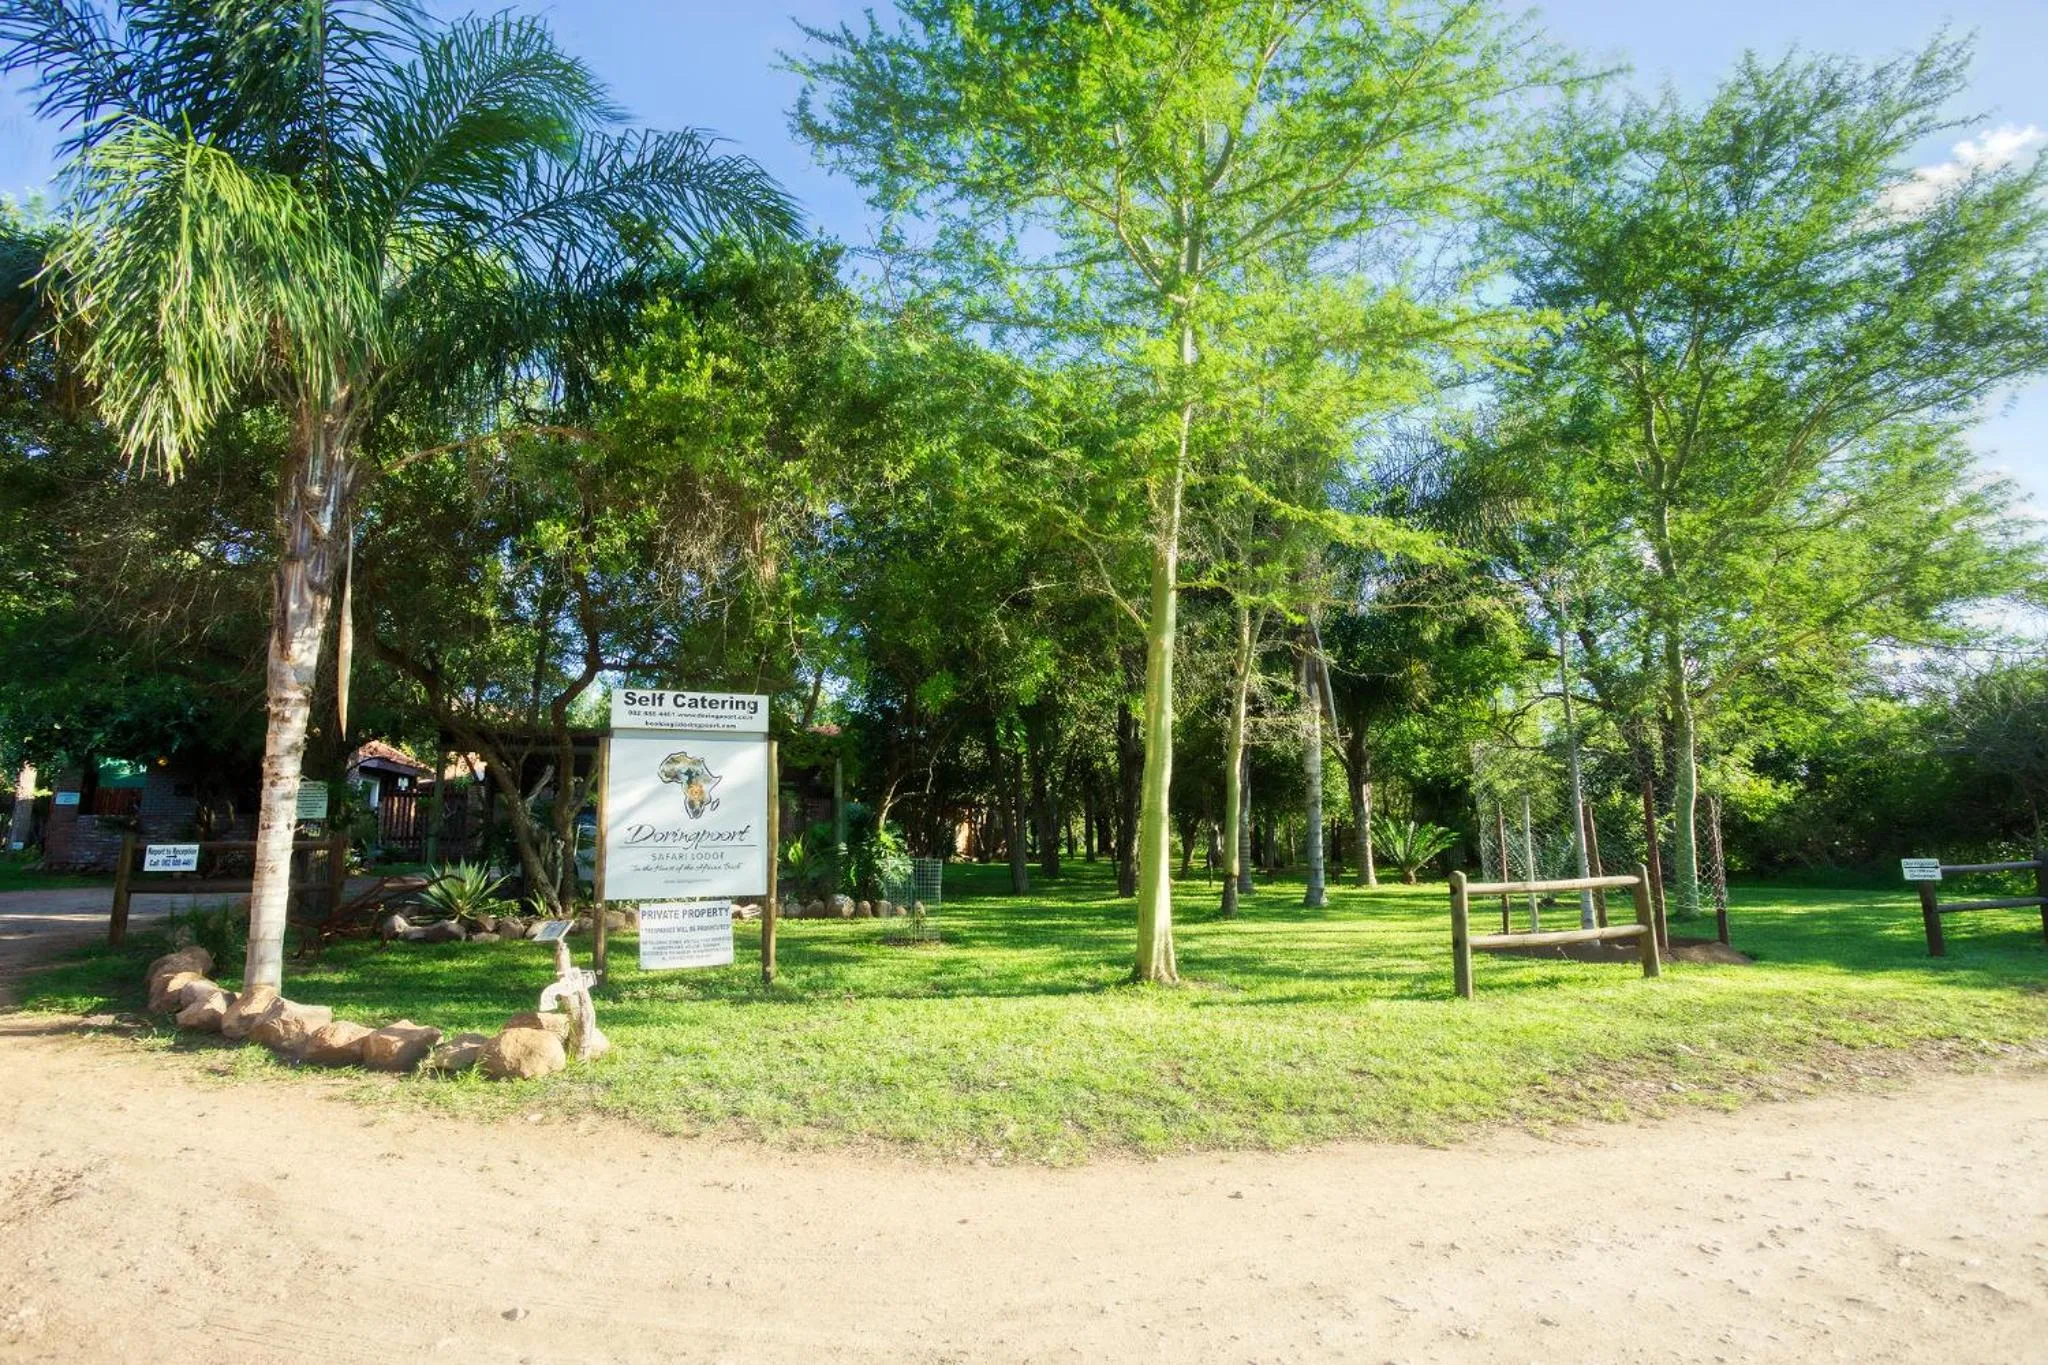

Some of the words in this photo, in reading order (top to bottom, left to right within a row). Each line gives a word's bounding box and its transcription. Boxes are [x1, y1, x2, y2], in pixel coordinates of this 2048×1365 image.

[623, 691, 665, 707] Self
[672, 693, 759, 714] Catering
[624, 823, 751, 850] Doringpoort
[650, 853, 688, 862] SAFARI
[641, 909, 680, 920] PRIVATE
[682, 907, 730, 919] PROPERTY
